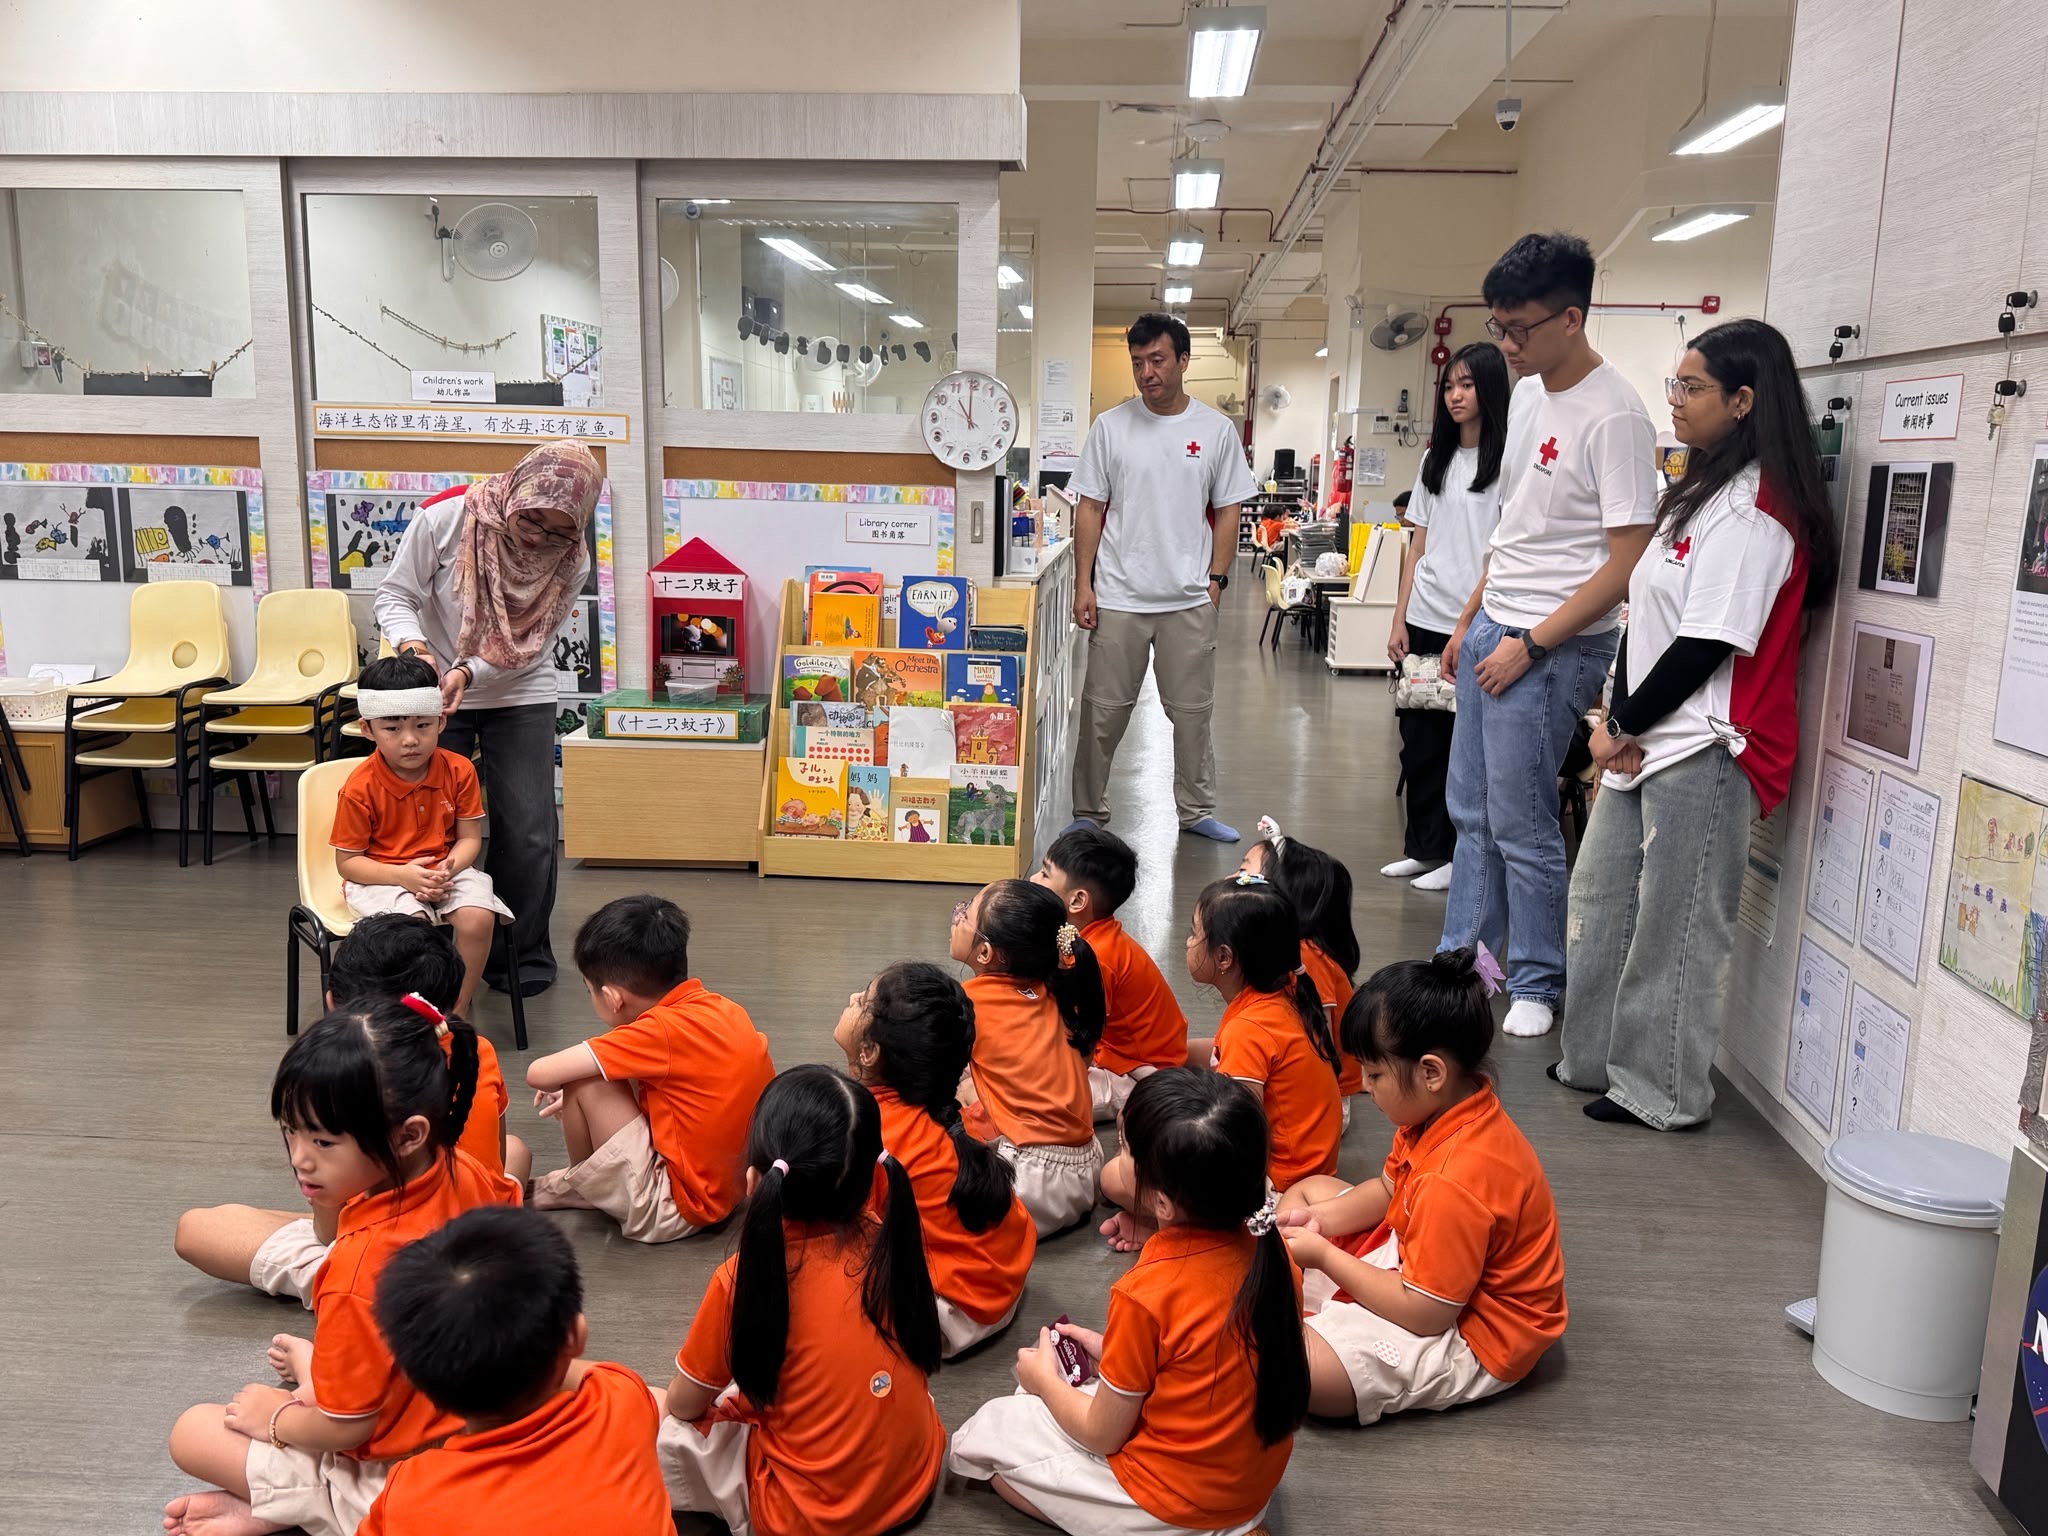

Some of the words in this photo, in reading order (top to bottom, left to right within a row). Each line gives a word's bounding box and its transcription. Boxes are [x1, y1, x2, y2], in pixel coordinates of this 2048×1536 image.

[422, 376, 462, 386] Children's
[463, 377, 484, 386] work
[436, 388, 471, 397] 幼儿作品
[950, 382, 961, 393] 11
[988, 385, 994, 398] 1
[934, 393, 947, 406] 10
[1895, 392, 1924, 408] Current
[1925, 392, 1949, 405] issues
[998, 401, 1007, 413] 2
[930, 412, 938, 424] 9
[1903, 413, 1935, 430] 新闻时事
[1001, 420, 1010, 432] 3
[933, 431, 942, 442] 8
[995, 438, 1003, 449] 4
[946, 445, 954, 457] 7
[981, 449, 989, 461] 5
[962, 452, 970, 464] 6
[859, 518, 889, 529] Library
[891, 520, 918, 528] corner
[871, 530, 905, 539] 图书角落
[657, 576, 739, 594] 十二只蚊子
[912, 589, 937, 600] EARN
[940, 590, 952, 600] IT!
[795, 658, 838, 670] Goldilocks
[907, 655, 926, 663] Meet
[895, 660, 939, 674] Orchestra
[617, 714, 726, 734] 《十二只蚊子》
